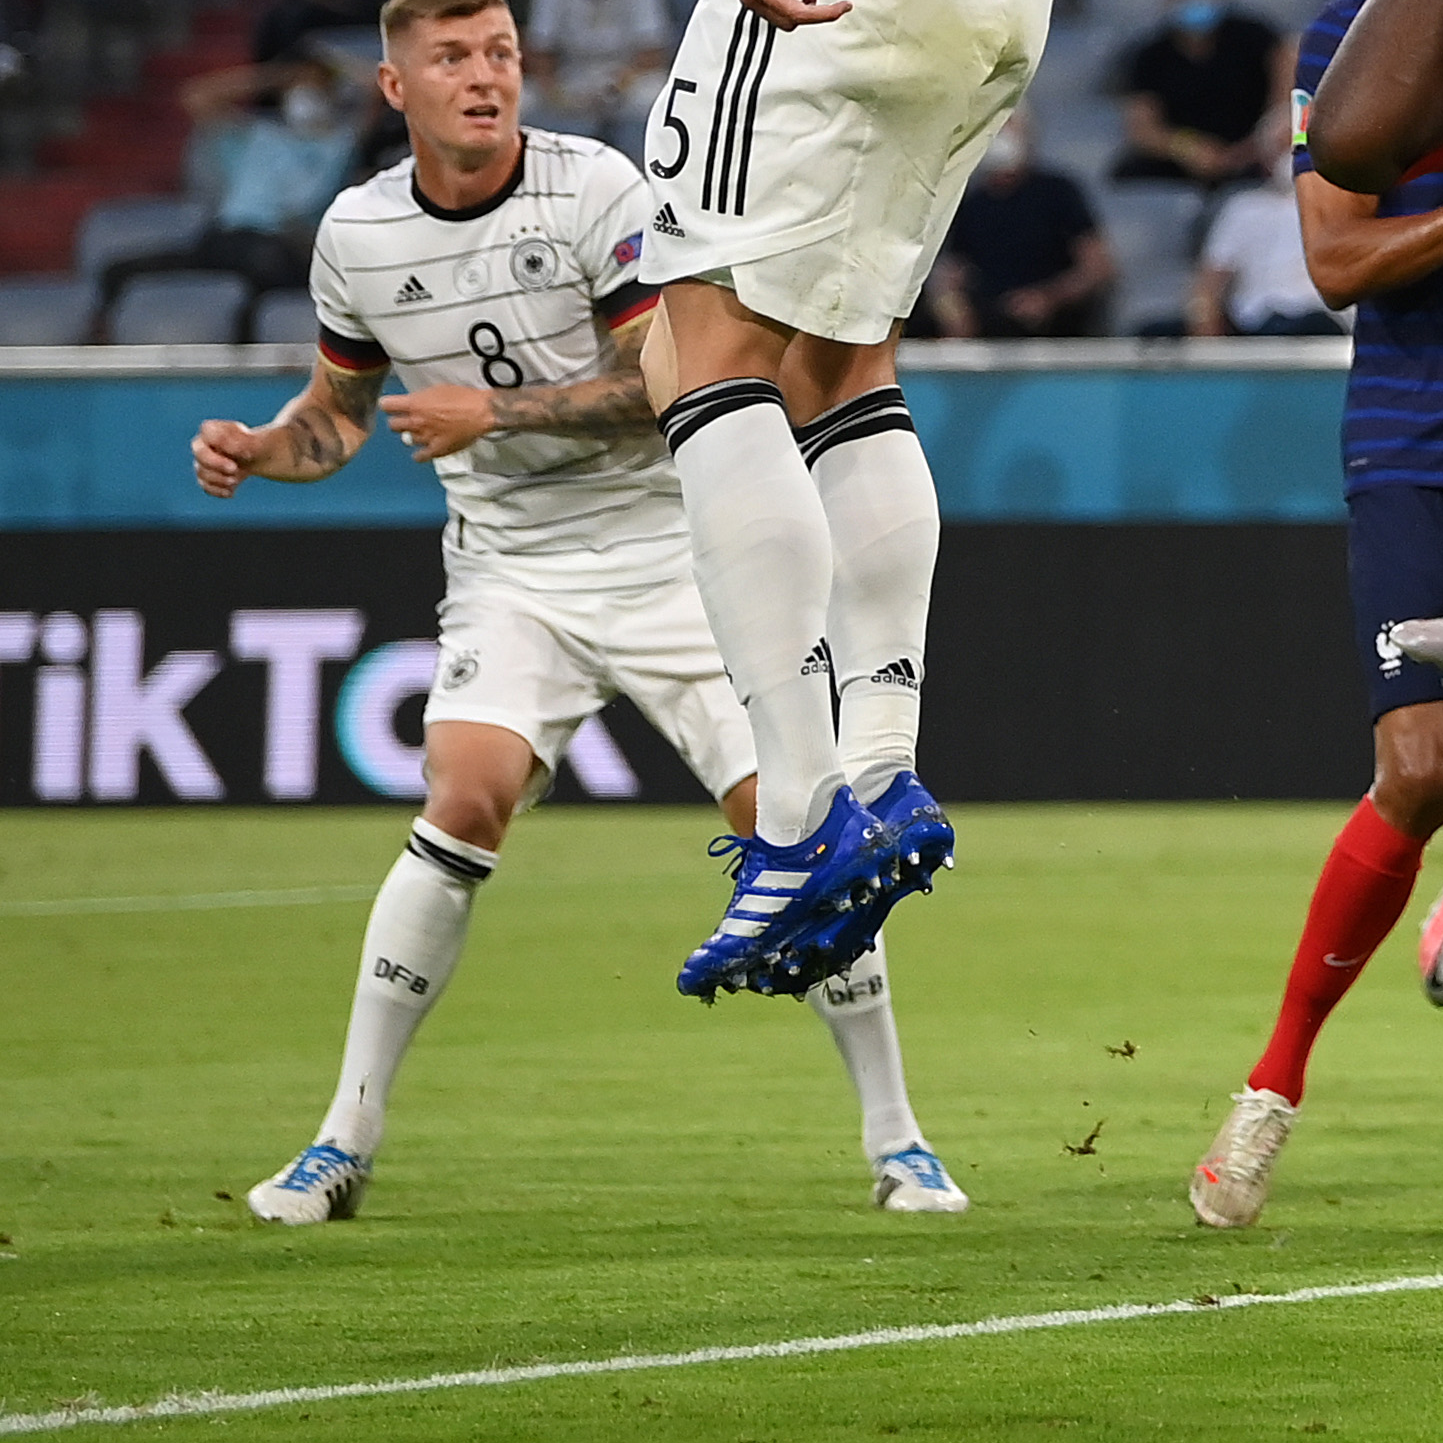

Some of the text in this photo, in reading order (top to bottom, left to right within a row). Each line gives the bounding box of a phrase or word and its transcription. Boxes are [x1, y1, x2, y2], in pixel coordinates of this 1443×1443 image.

[650, 77, 697, 180] 5
[468, 321, 524, 389] 8
[0, 609, 641, 801] ikTo
[870, 674, 918, 691] adidas
[374, 956, 430, 997] DFB
[827, 973, 883, 1007] DFB
